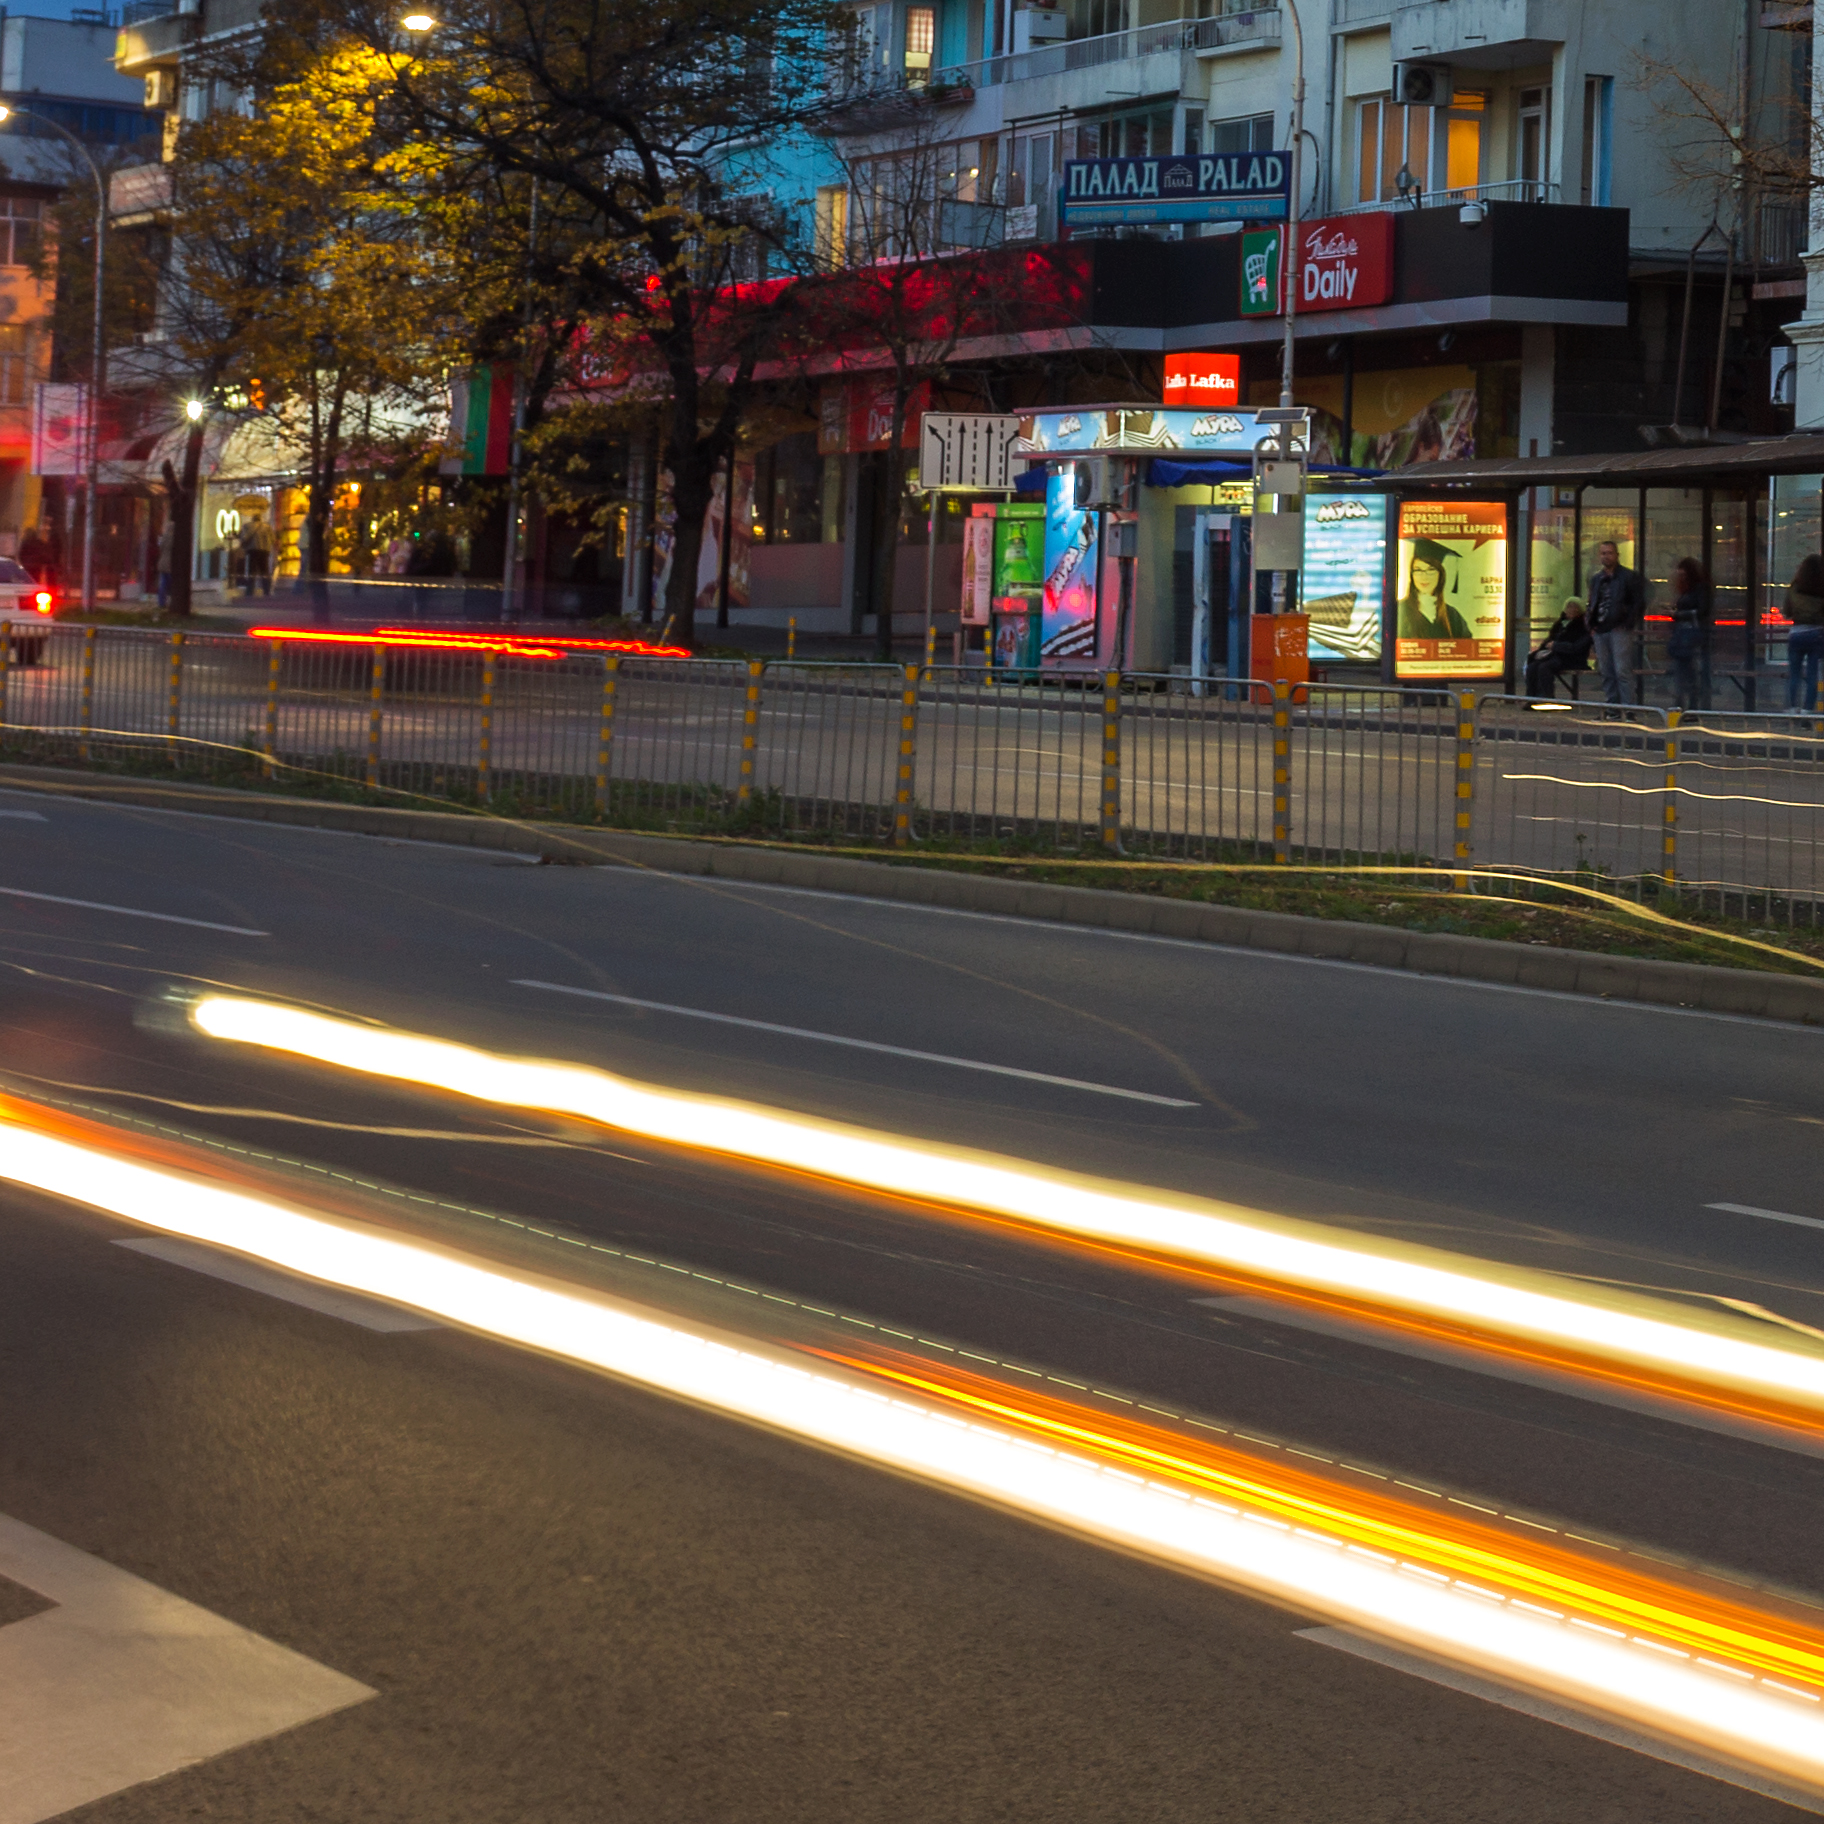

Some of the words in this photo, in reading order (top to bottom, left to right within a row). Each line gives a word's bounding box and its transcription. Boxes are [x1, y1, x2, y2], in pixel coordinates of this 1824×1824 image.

[1069, 160, 1159, 197] ПАЛАД
[1198, 155, 1283, 192] PALAD
[1304, 259, 1358, 301] Daily
[1189, 373, 1235, 390] Lafka
[1402, 524, 1415, 533] ЗА
[1416, 524, 1461, 533] УСПЕШНА
[1463, 524, 1503, 534] КАРИЕРА
[1403, 513, 1468, 523] ОБРАЗОВАНИЕ
